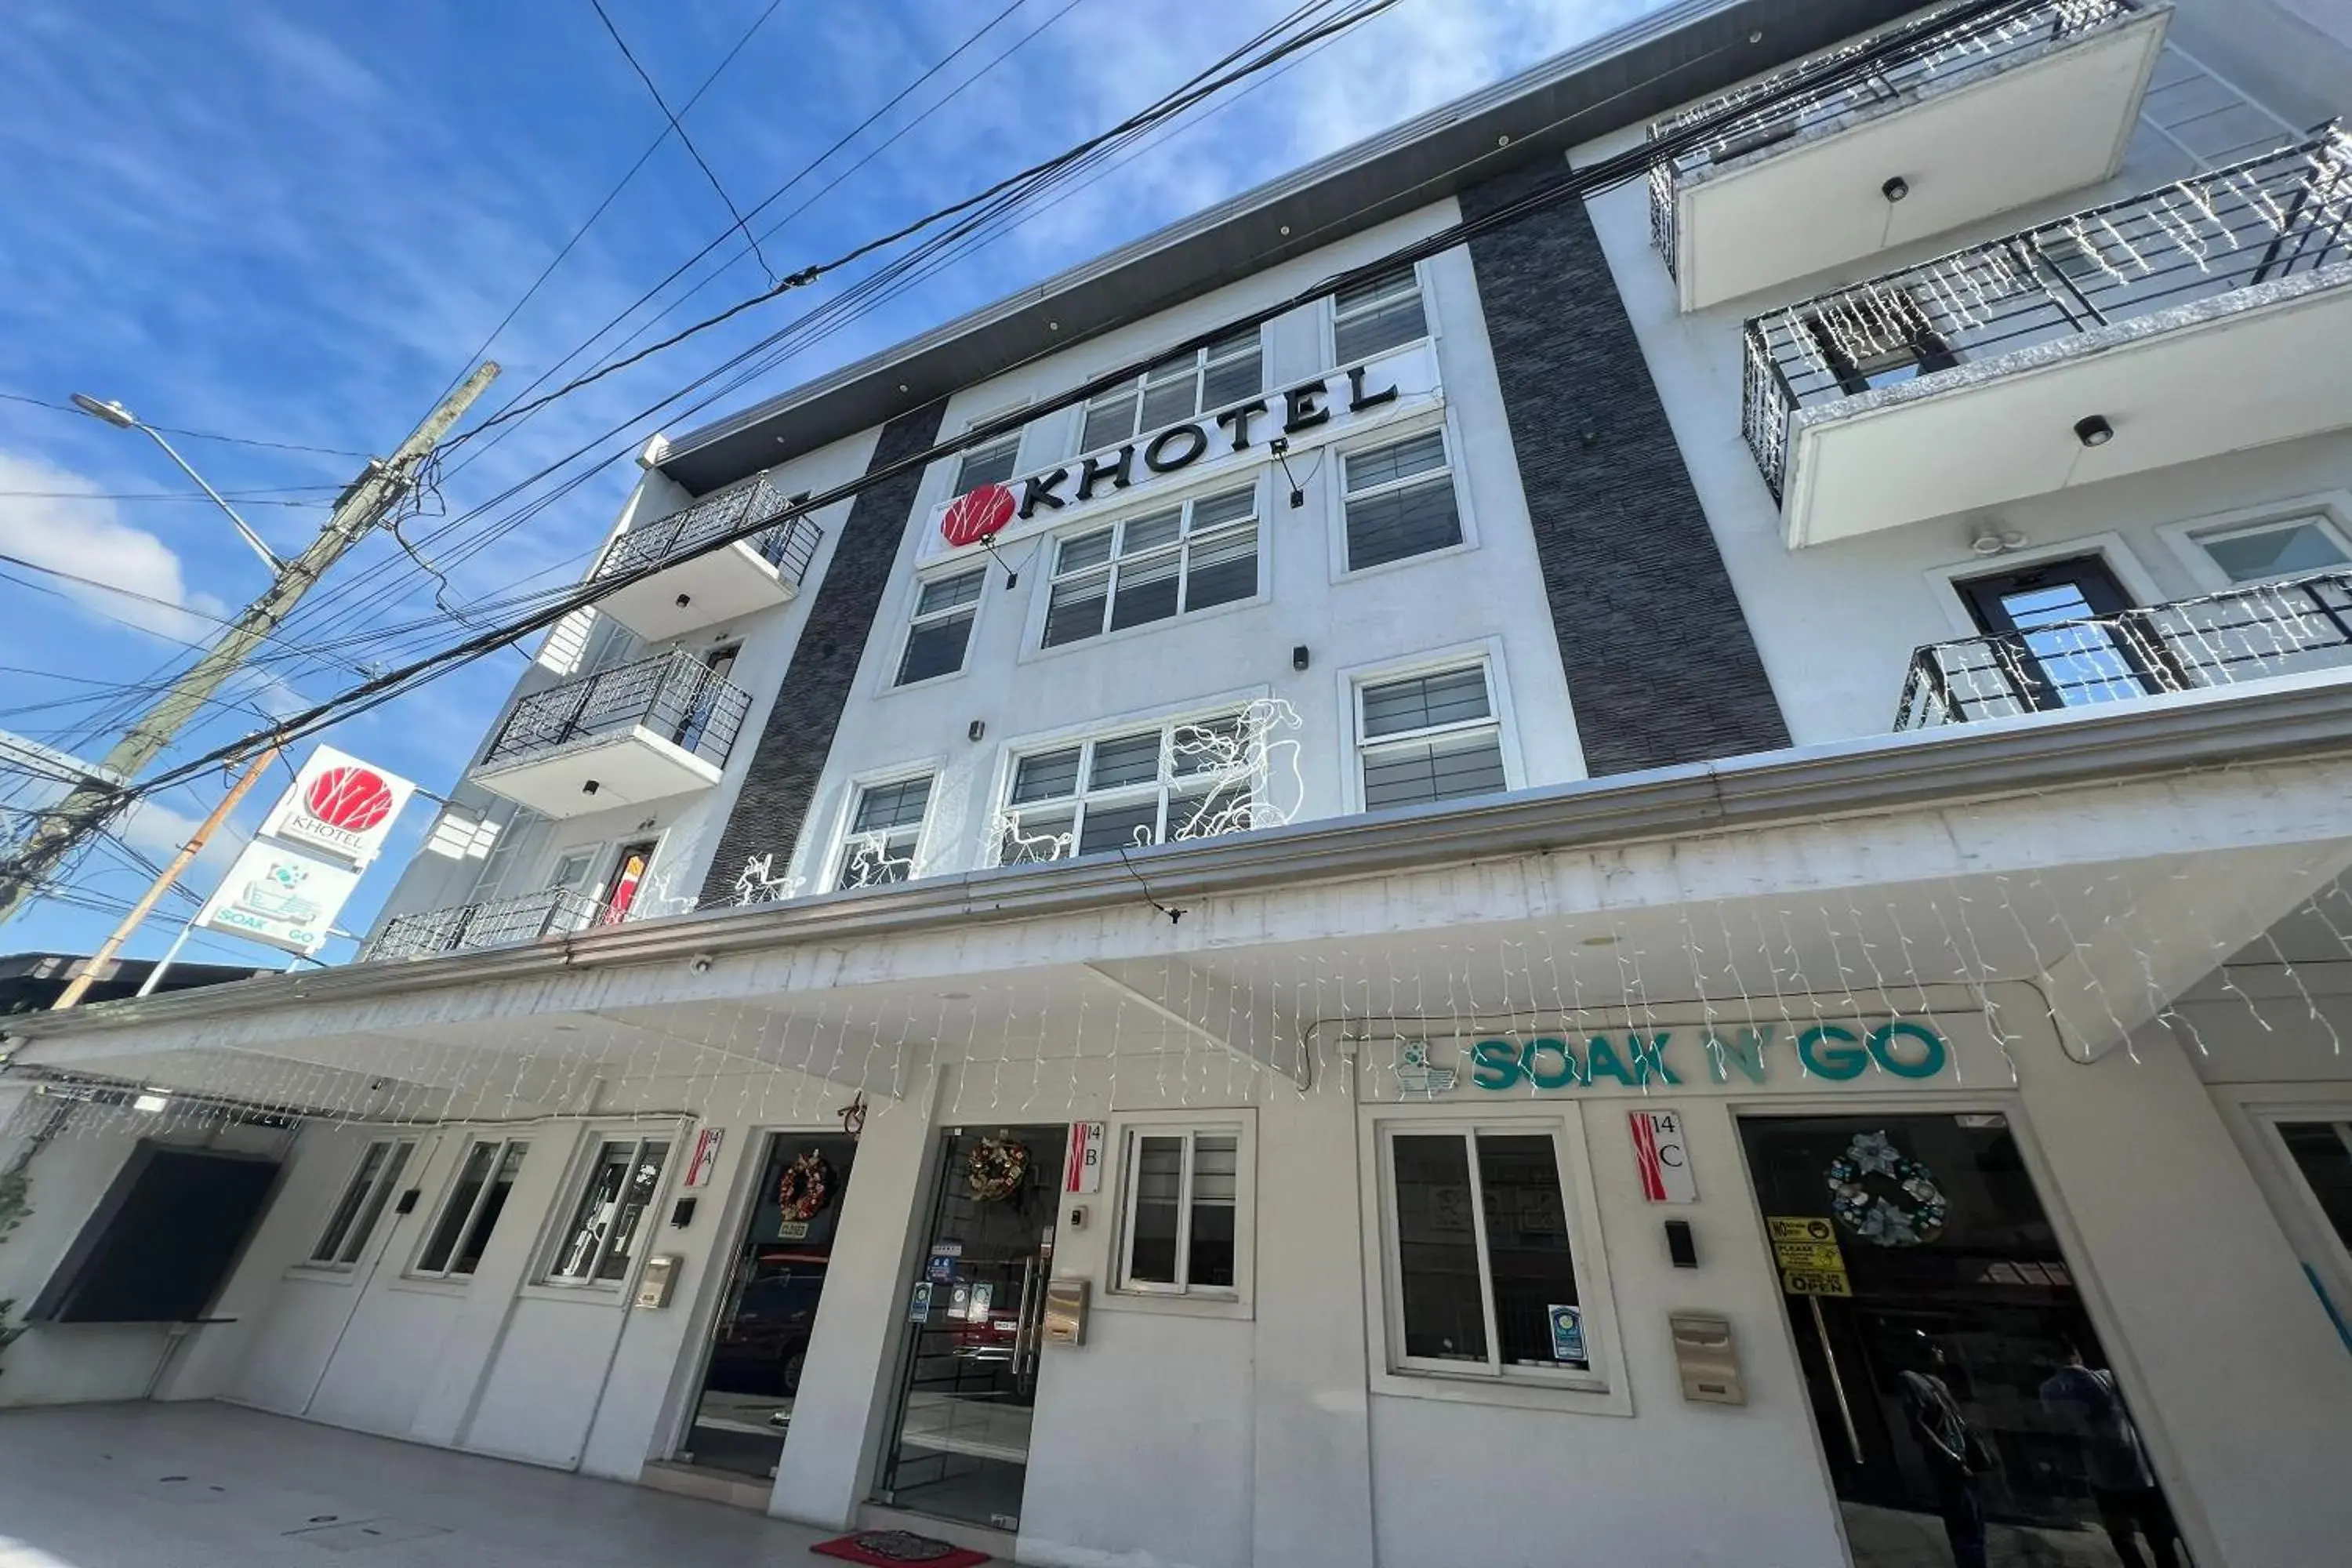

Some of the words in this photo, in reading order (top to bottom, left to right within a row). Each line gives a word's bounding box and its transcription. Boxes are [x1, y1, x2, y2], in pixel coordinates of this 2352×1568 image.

[1017, 366, 1398, 519] KHOTEL
[292, 815, 362, 849] KHOTEL
[217, 909, 267, 930] SOAK
[289, 929, 314, 942] GO
[1470, 1031, 1682, 1090] SOAK
[1798, 1022, 1947, 1081] GO
[1087, 1124, 1100, 1140] 14
[1651, 1115, 1675, 1134] 14
[702, 1150, 711, 1164] A
[1085, 1148, 1097, 1166] B
[1659, 1144, 1683, 1167] C
[1792, 1276, 1843, 1293] OPEN
